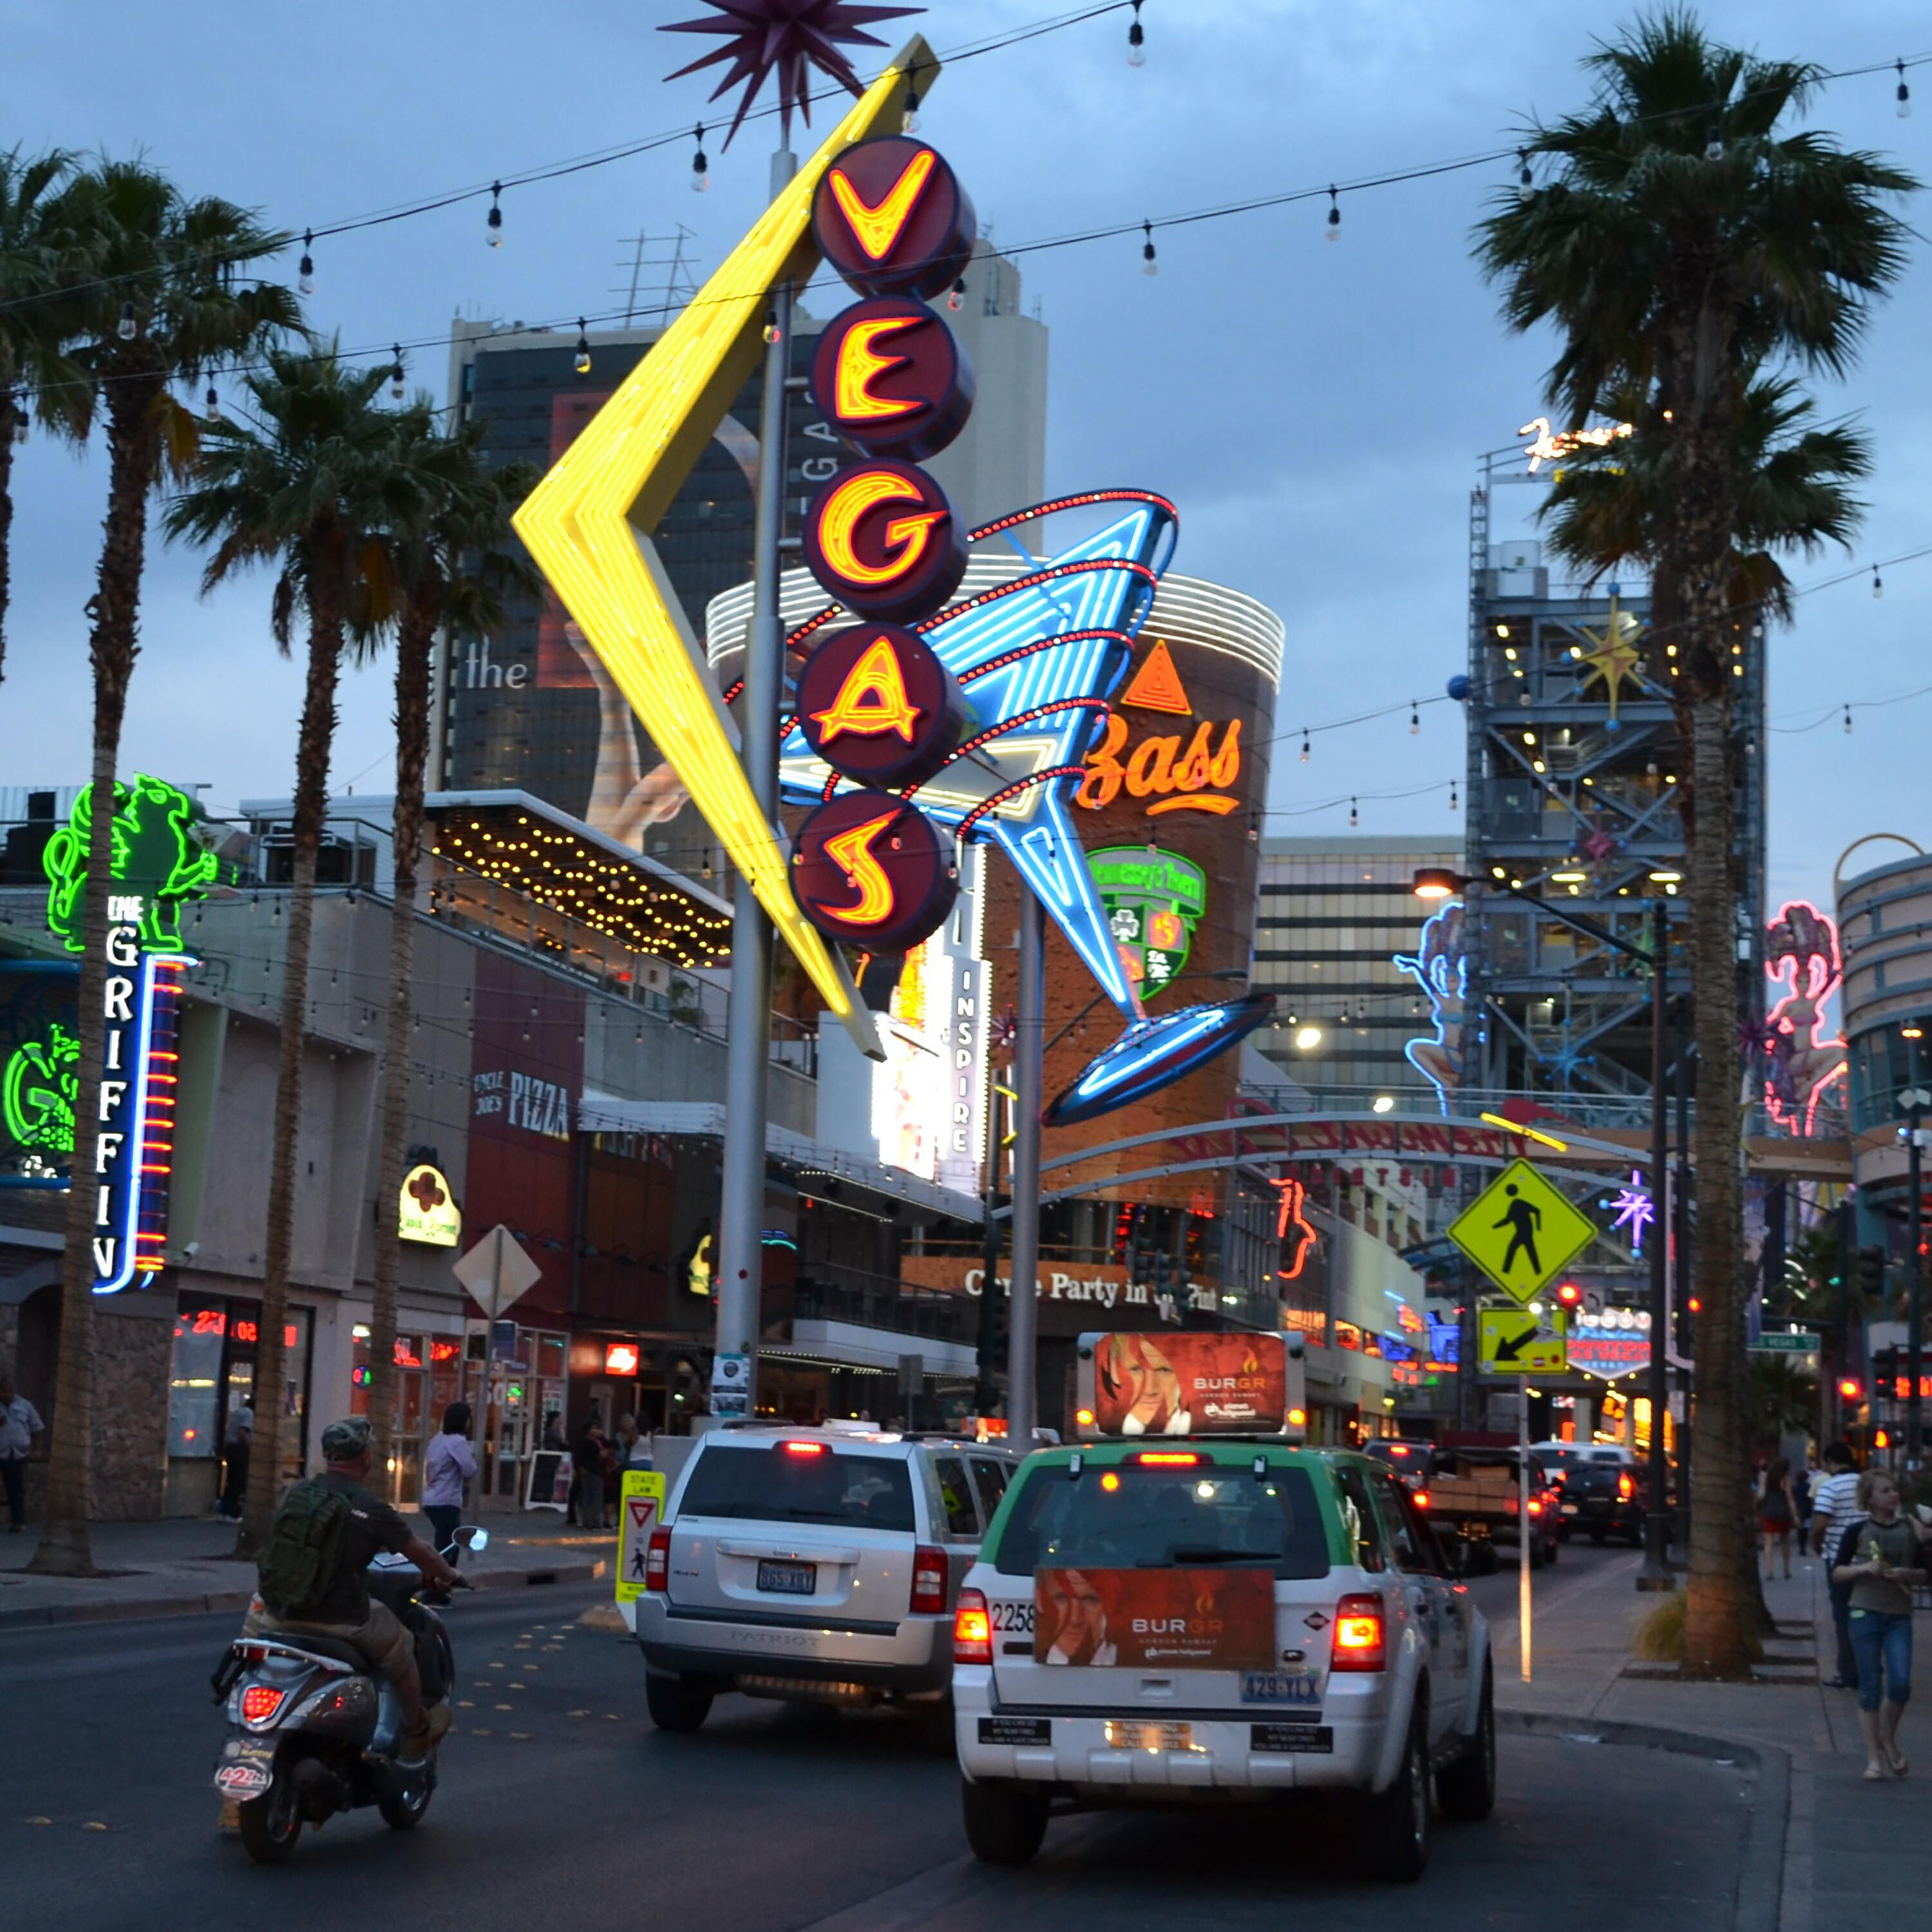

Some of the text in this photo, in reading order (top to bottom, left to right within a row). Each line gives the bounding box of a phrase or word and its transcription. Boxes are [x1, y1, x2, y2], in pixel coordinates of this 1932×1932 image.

[808, 149, 949, 925] VEGAS
[465, 633, 527, 689] the
[1076, 714, 1242, 810] Bass
[952, 970, 975, 1153] INSPIRE
[508, 1072, 570, 1142] PIZZA
[1049, 1273, 1117, 1308] Party
[1124, 1277, 1148, 1304] in
[1193, 1377, 1266, 1390] BURGR
[630, 1475, 656, 1484] STATE
[634, 1486, 651, 1494] LAW
[731, 1630, 820, 1647] PATRIOT
[1132, 1618, 1224, 1633] BURGR
